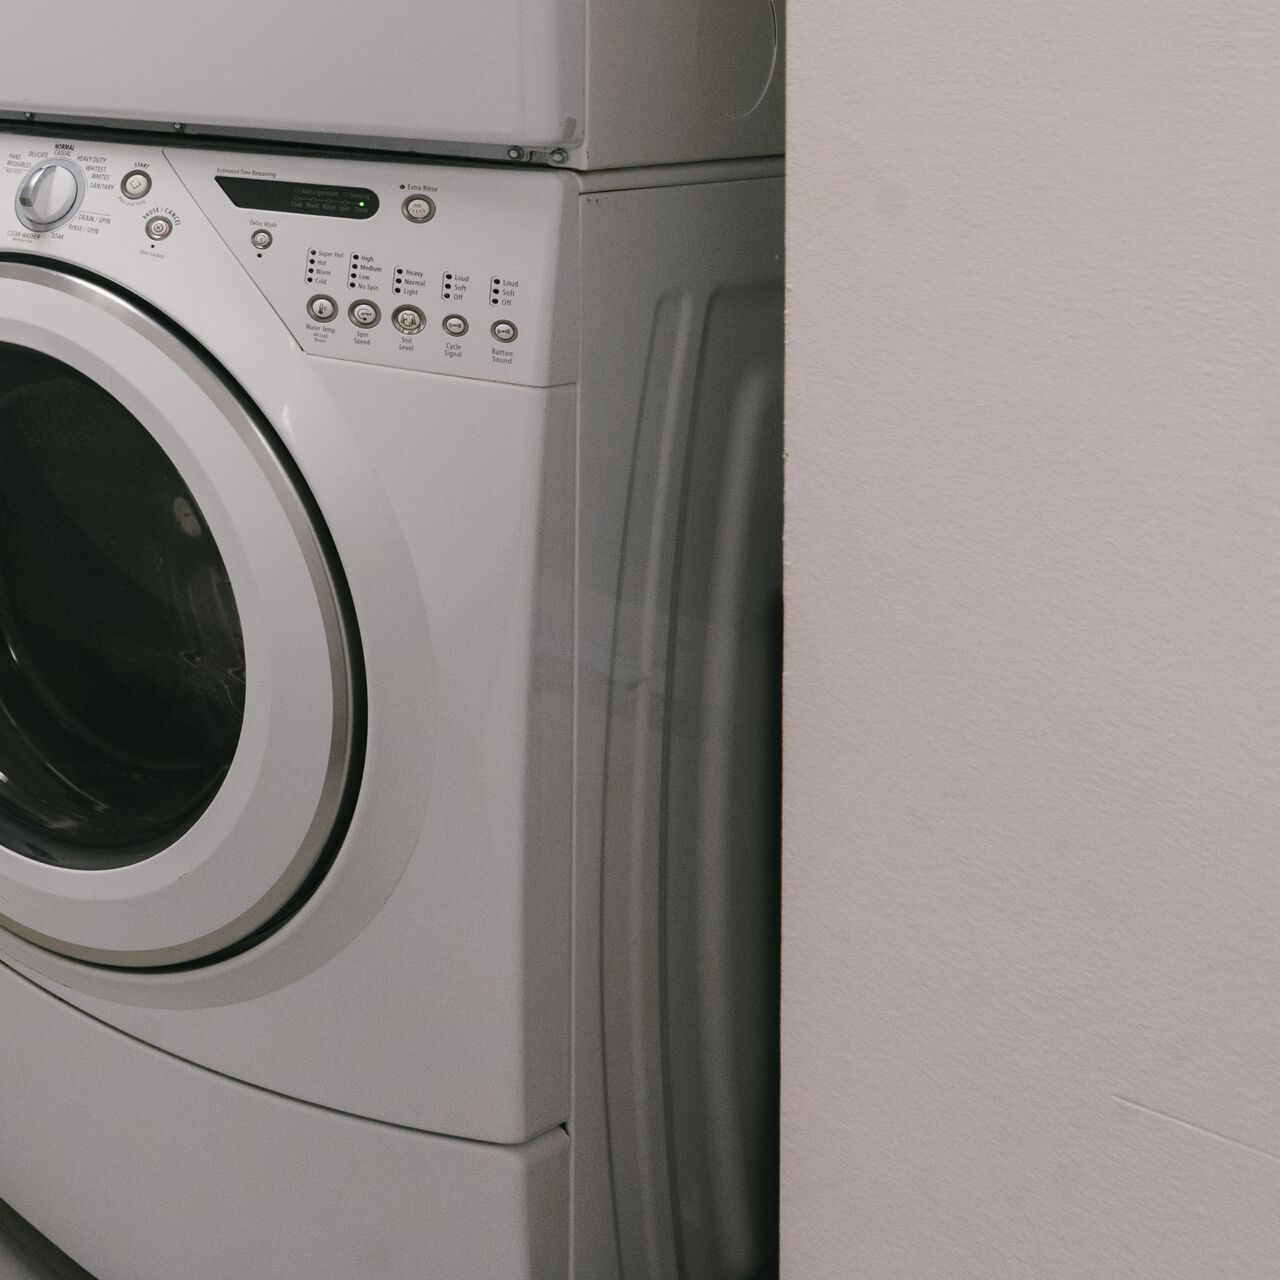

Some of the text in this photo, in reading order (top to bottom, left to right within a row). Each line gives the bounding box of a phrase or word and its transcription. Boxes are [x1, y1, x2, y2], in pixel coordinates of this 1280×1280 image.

[28, 150, 49, 158] DELICATE
[54, 149, 72, 157] CASUAL
[85, 165, 107, 173] WHITEST
[216, 167, 240, 175] Estimated
[252, 170, 277, 179] Remaining
[89, 182, 114, 191] SANITARY
[407, 183, 438, 193] Extra Rinse
[78, 214, 95, 222] DRAIN
[98, 217, 112, 225] SPIN
[142, 207, 159, 220] PAUSE
[164, 207, 181, 227] CANCEL
[68, 223, 83, 231] RINSE
[249, 219, 264, 228] Delay
[21, 232, 41, 240] WASHER
[51, 232, 65, 240] SOAK
[318, 250, 344, 259] Super Hot
[361, 255, 374, 263] High
[316, 268, 331, 276] Warm
[360, 264, 382, 273] Medium
[358, 273, 370, 281] Low
[405, 269, 423, 278] Heavy
[454, 274, 470, 282] Loud
[404, 279, 426, 287] Normal
[502, 280, 519, 288] Loud
[367, 284, 379, 292] Spin
[403, 288, 418, 296] Light
[454, 284, 467, 292] Soft
[453, 293, 464, 301] Off
[502, 289, 515, 297] Soft
[501, 299, 512, 307] Off
[305, 323, 336, 334] Water Temp
[357, 331, 369, 339] Spin
[353, 337, 371, 346] Speed
[399, 343, 414, 352] Level
[445, 342, 462, 351] Cycle
[444, 350, 463, 359] Signal
[491, 348, 514, 357] Button
[492, 356, 513, 365] Sound
